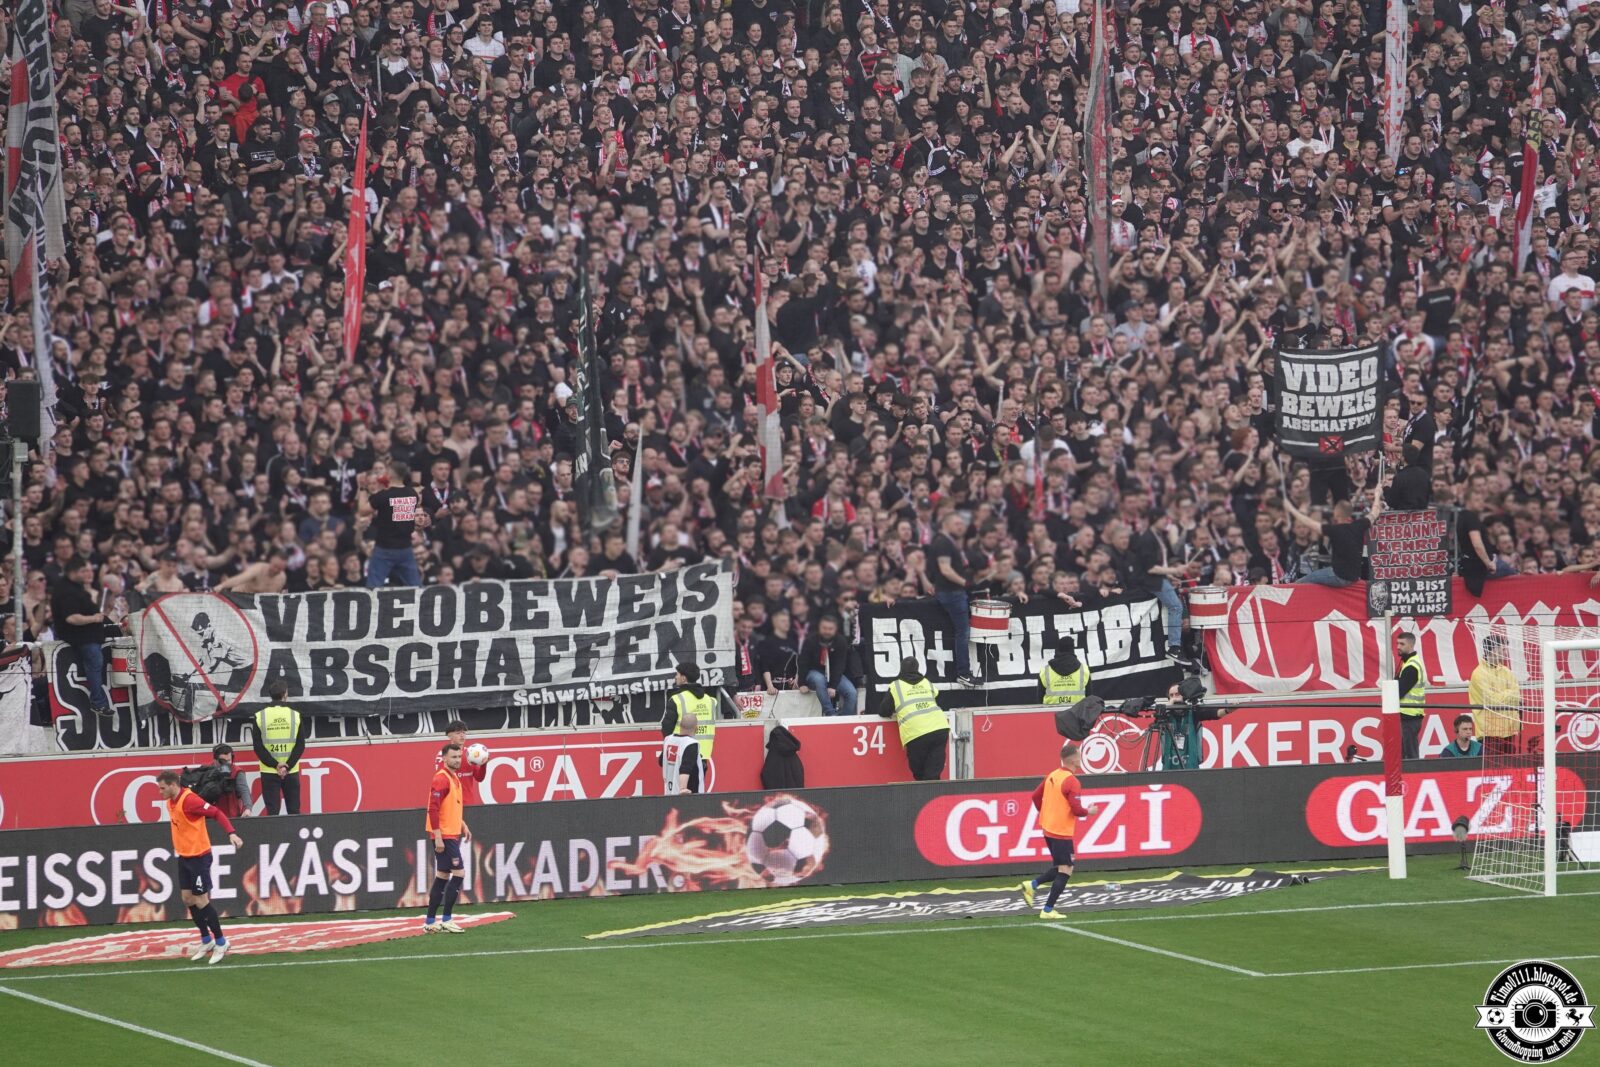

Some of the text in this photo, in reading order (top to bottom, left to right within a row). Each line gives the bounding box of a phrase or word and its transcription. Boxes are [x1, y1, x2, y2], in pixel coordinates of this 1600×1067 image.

[1281, 356, 1378, 393] VIDEO
[1281, 387, 1376, 417] BEWEIS
[1369, 520, 1447, 540] VERBANNTE
[1376, 511, 1437, 525] JEDER
[1377, 537, 1441, 553] KEHRT
[1391, 580, 1447, 592] DU BIST
[1391, 591, 1447, 604] IMMER
[258, 566, 720, 643] VIDEOBEWEIS
[1391, 603, 1448, 614] BEI UNS!
[260, 613, 718, 697] ABSCHAFFEN!
[872, 617, 983, 678] 50+
[513, 676, 676, 707] Schwabenstur
[270, 744, 288, 752] 2411
[852, 725, 886, 756] 34
[478, 752, 662, 804] GAZ
[0, 845, 237, 911] EISSESE
[259, 827, 395, 899] KÄSE
[195, 875, 203, 887] 4
